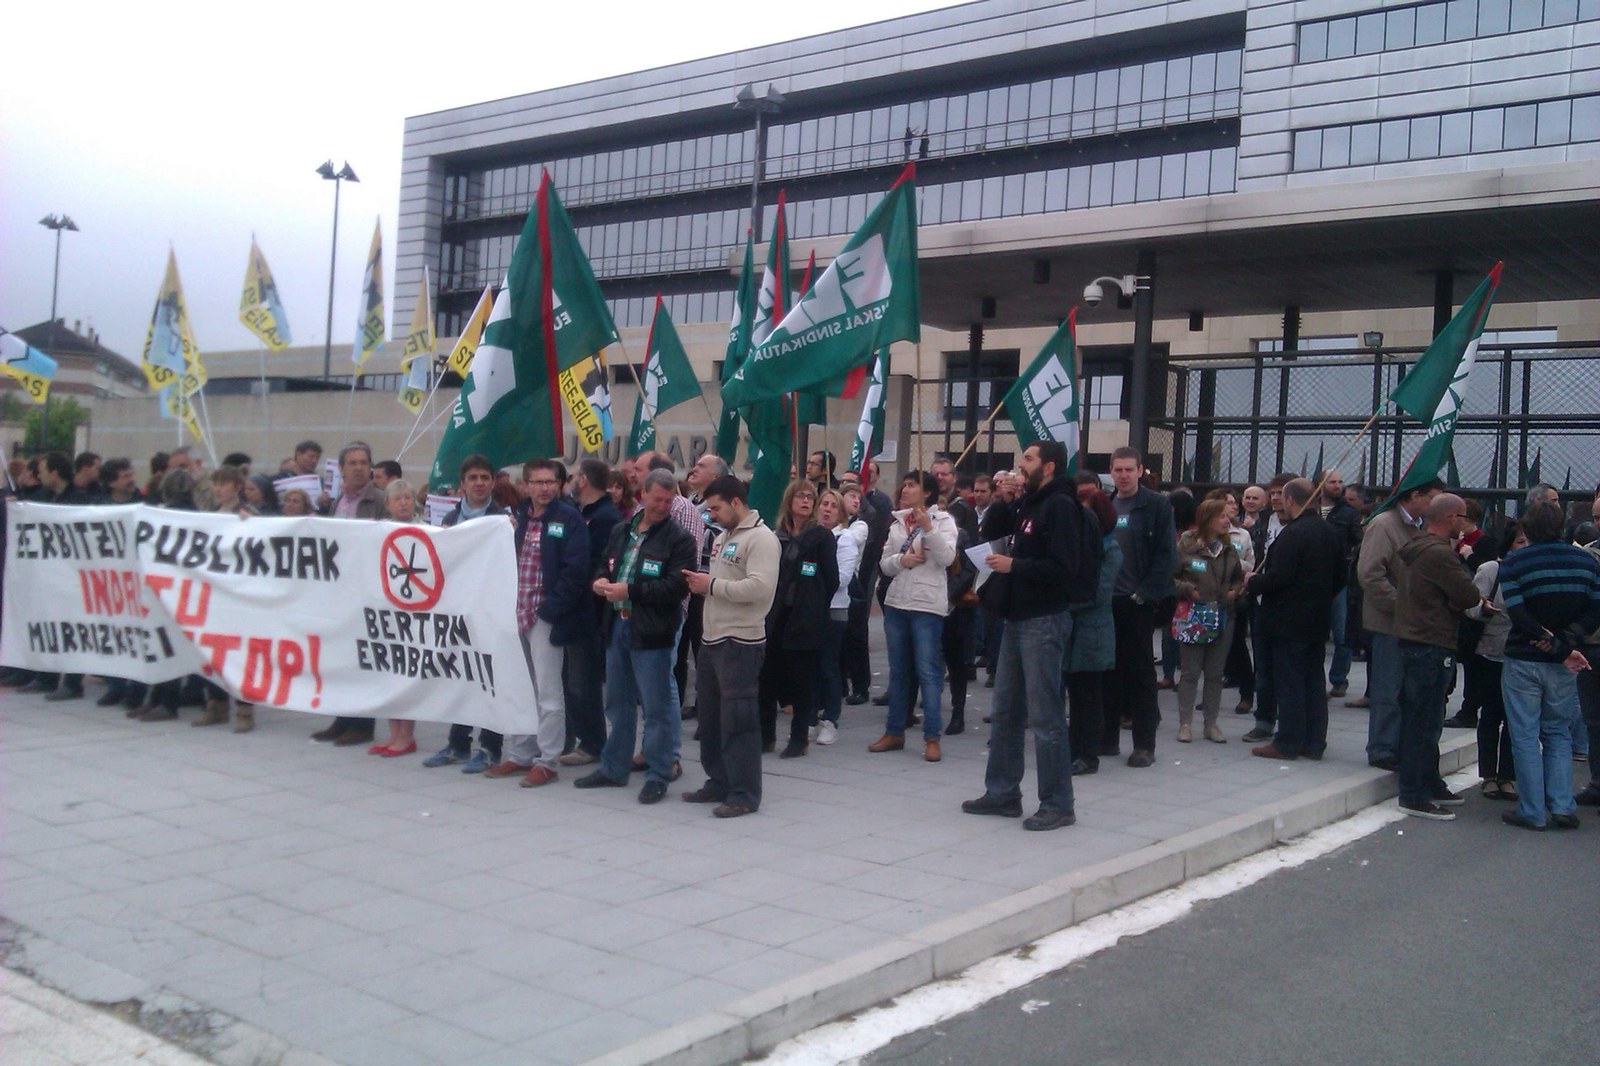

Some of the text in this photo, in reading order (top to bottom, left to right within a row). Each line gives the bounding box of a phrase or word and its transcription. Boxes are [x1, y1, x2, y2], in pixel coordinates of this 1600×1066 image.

[560, 368, 604, 446] TEE-EILAS
[135, 520, 340, 582] PUBLIKOAK
[363, 607, 472, 648] BERTAN
[182, 628, 322, 710] TOP!
